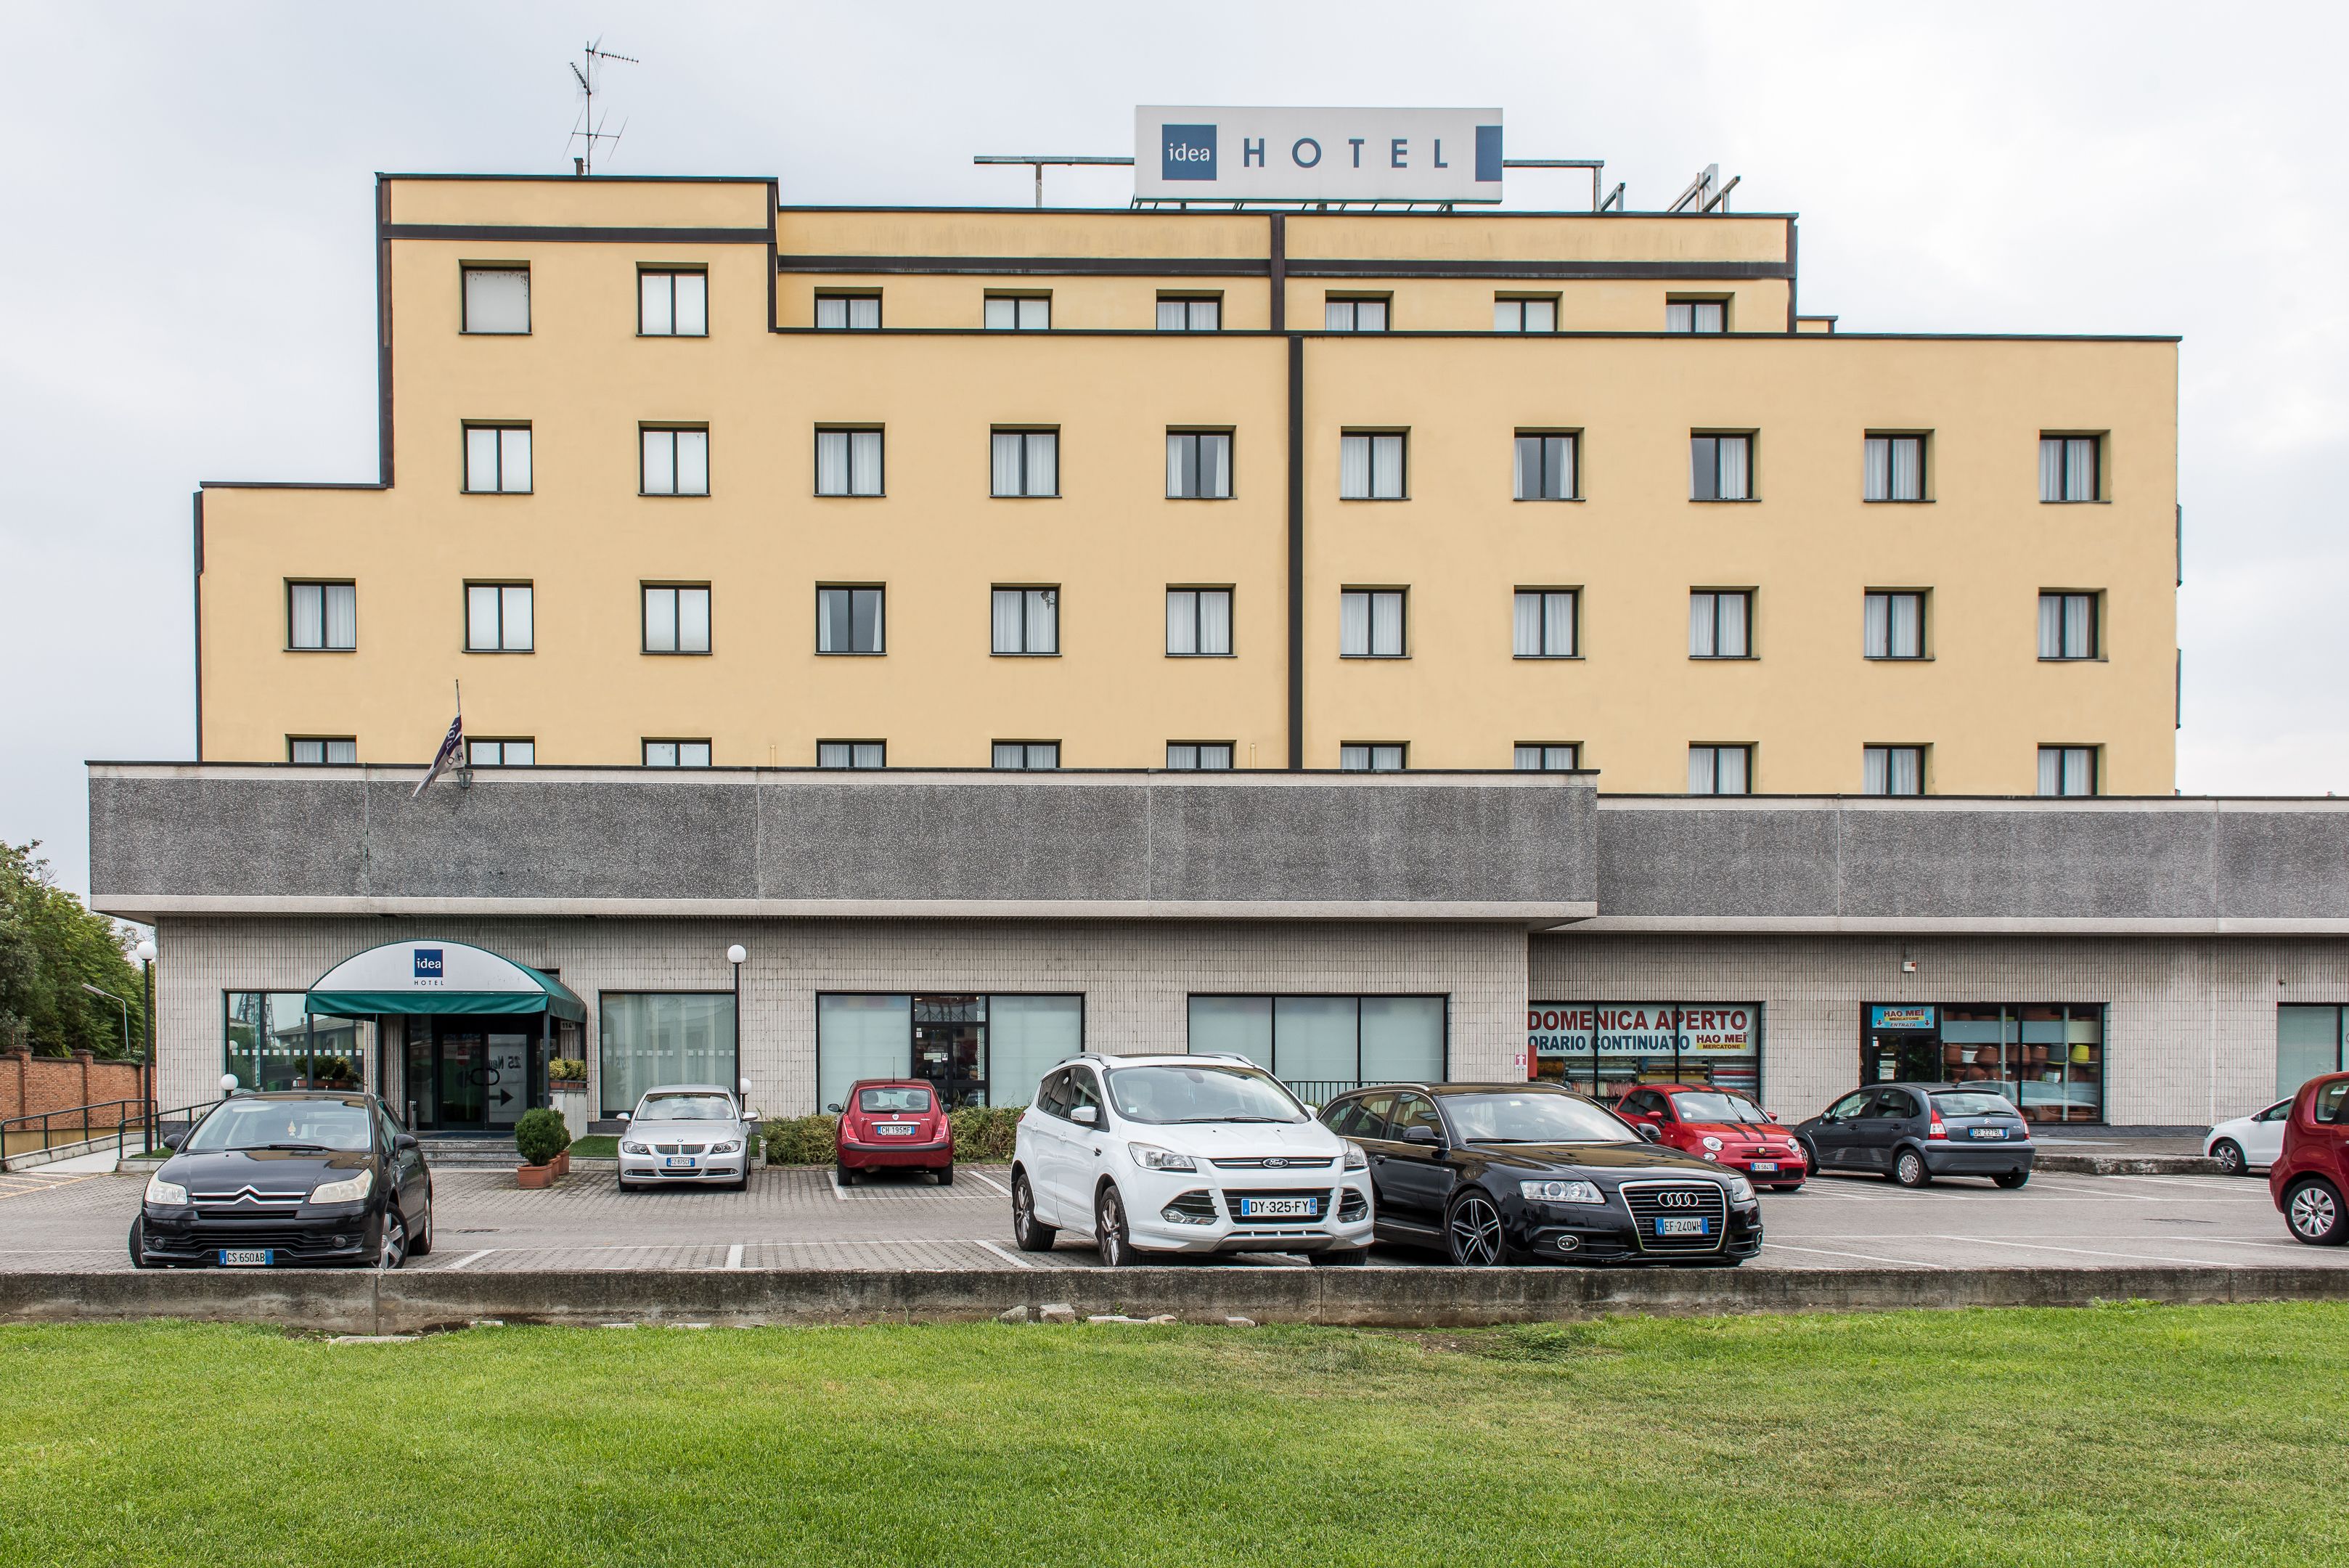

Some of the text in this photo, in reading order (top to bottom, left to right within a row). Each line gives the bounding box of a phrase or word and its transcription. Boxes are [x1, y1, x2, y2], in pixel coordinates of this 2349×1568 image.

[1168, 137, 1448, 169] idea HOTEL
[416, 957, 441, 969] idea
[1528, 1010, 1747, 1031] DOMENICA APERTO
[1528, 1035, 1690, 1050] ORARIO CONTINUATO
[1696, 1034, 1721, 1044] HAO
[1250, 1201, 1309, 1213] DY-325-FY
[227, 1252, 265, 1262] CS 650AB
